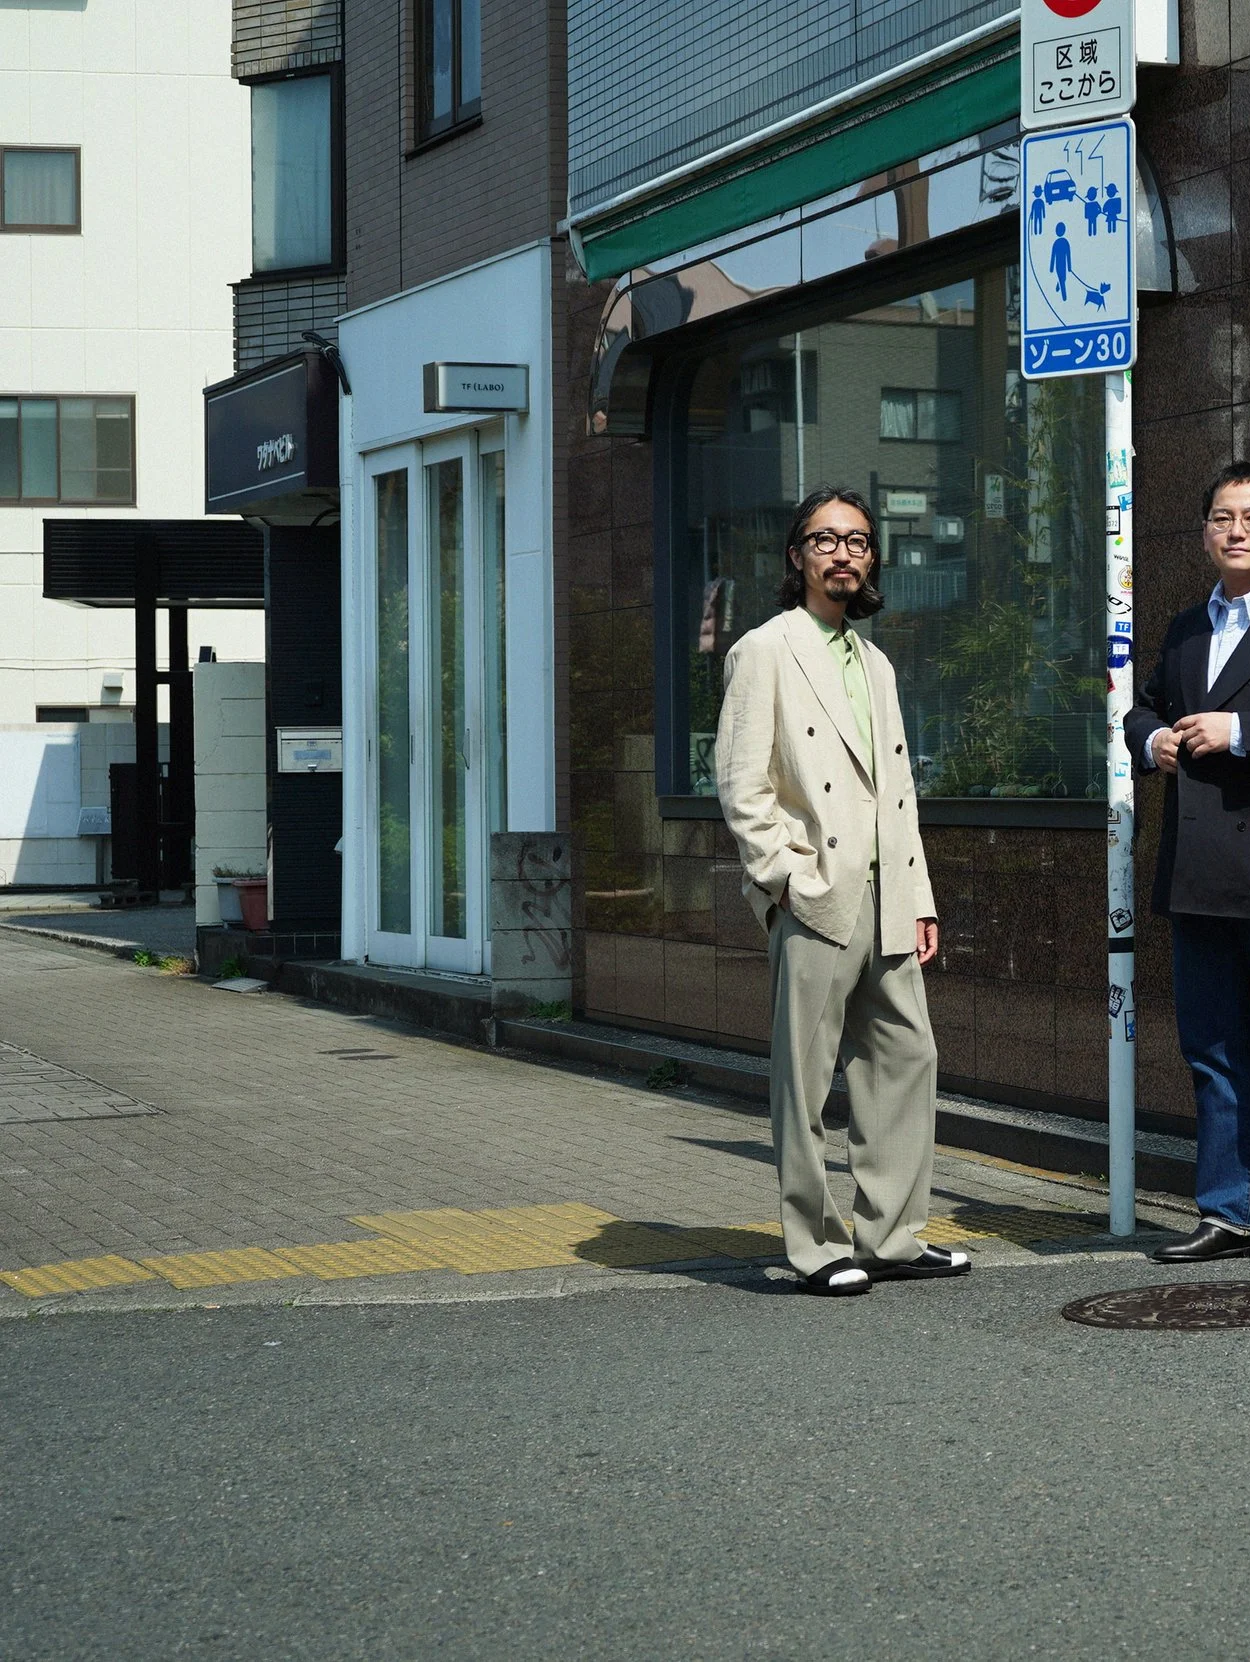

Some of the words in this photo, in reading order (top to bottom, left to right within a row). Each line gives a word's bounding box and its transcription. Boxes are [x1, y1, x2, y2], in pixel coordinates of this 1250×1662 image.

[1056, 38, 1098, 70] 区域
[1039, 70, 1116, 104] ここから
[1029, 331, 1126, 369] ゾーン30
[473, 382, 504, 392] (LABO)
[1118, 622, 1129, 631] TF
